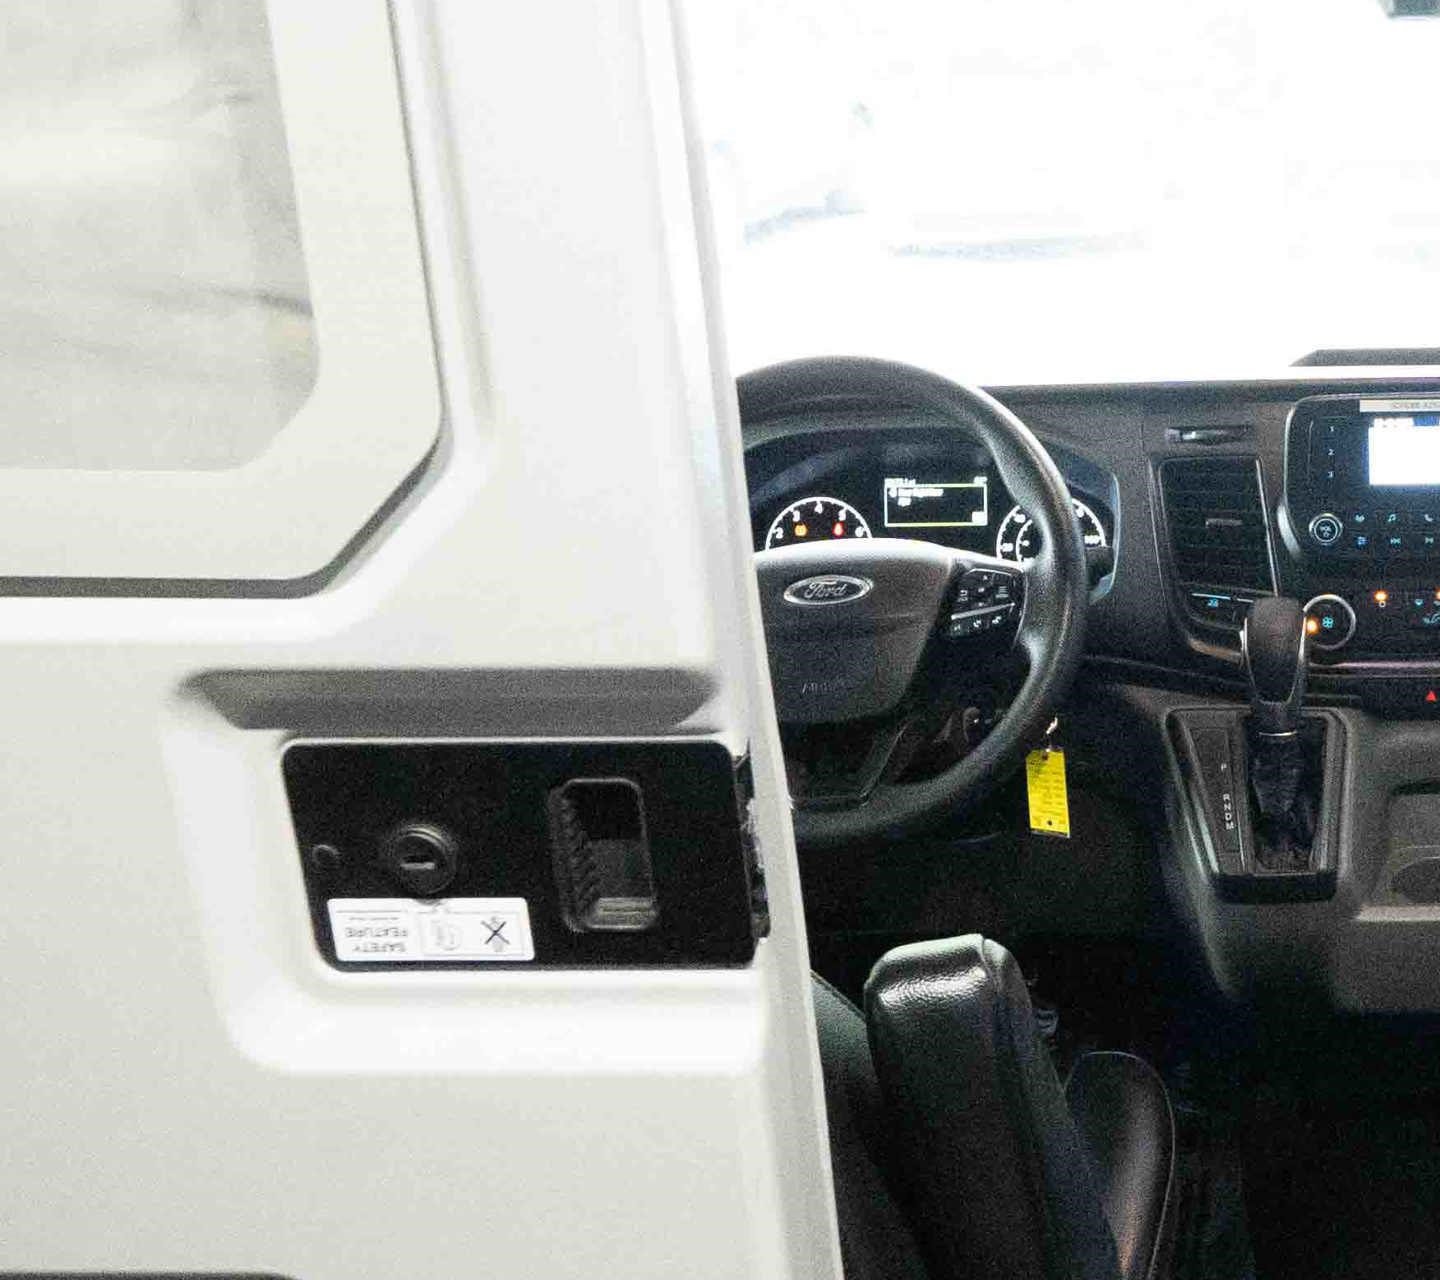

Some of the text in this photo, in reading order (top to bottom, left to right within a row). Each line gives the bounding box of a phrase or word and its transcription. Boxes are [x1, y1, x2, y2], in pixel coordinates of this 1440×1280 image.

[803, 581, 849, 599] Ford
[1225, 812, 1232, 821] D
[345, 927, 409, 938] FEATURE
[352, 942, 407, 953] SAFETY
